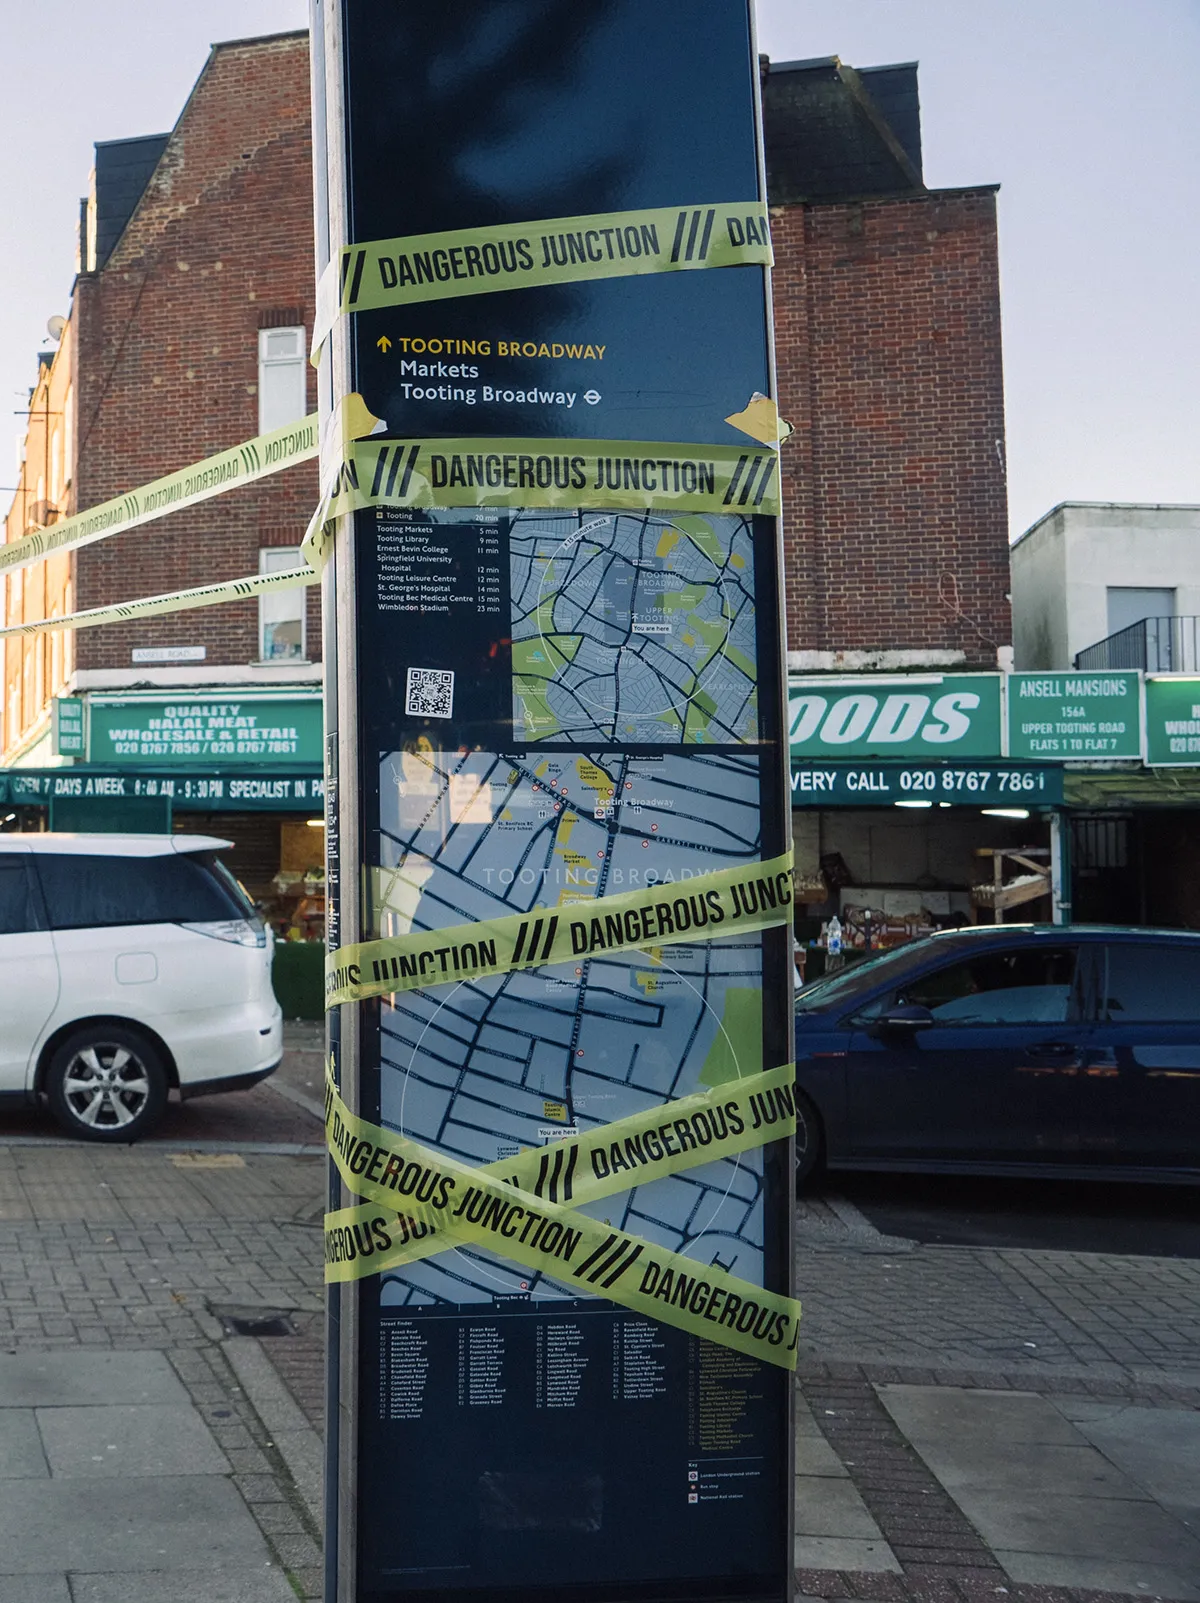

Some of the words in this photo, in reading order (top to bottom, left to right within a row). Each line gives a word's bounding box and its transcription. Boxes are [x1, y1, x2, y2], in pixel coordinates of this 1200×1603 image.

[378, 239, 535, 289] DANGEROUS
[541, 223, 660, 268] JUNCTION
[399, 337, 491, 356] TOOTING
[498, 340, 606, 360] BROADWAY
[400, 360, 479, 379] Markets
[401, 383, 476, 404] Tooting
[482, 386, 577, 408] Broadway
[430, 453, 587, 490] DANGEROUS
[593, 457, 715, 494] JUNCTION
[386, 512, 412, 520] Tooting
[573, 526, 593, 540] minute
[594, 519, 606, 528] walk
[405, 536, 429, 544] Library
[1020, 680, 1062, 697] ANSELL
[1066, 679, 1127, 696] MANSIONS
[164, 705, 241, 718] QUALITY
[1062, 707, 1086, 717] 156A
[148, 718, 204, 730] HALAL
[208, 717, 257, 728] MEAT
[1022, 723, 1052, 734] UPPER
[1056, 723, 1096, 734] TOOTING
[1099, 722, 1125, 733] ROAD
[109, 729, 215, 742] WHOLESALE
[237, 728, 299, 739] RETAIL
[115, 742, 138, 754] 020
[141, 743, 167, 754] 8767
[1030, 739, 1058, 750] FLATS
[1071, 739, 1082, 750] TO
[1085, 739, 1107, 749] FLAT
[1111, 739, 1117, 749] 7
[14, 777, 40, 793] OPEN
[55, 778, 82, 795] DAYS
[230, 781, 290, 798] SPECIALIST
[295, 781, 305, 798] IN
[846, 772, 889, 790] CALL
[900, 771, 936, 790] 020
[942, 771, 991, 790] 8767
[554, 793, 572, 807] ROAD
[594, 798, 629, 806] Tooting
[631, 798, 674, 807] Broadway
[482, 868, 598, 884] TOOTING
[372, 938, 497, 982] JUNCTION
[570, 890, 725, 955] DANGEROUS
[590, 1101, 744, 1179] DANGEROUS
[332, 1110, 456, 1210] DANGEROUS
[452, 1186, 583, 1262] JUNCTION
[638, 1260, 790, 1346] DANGEROUS
